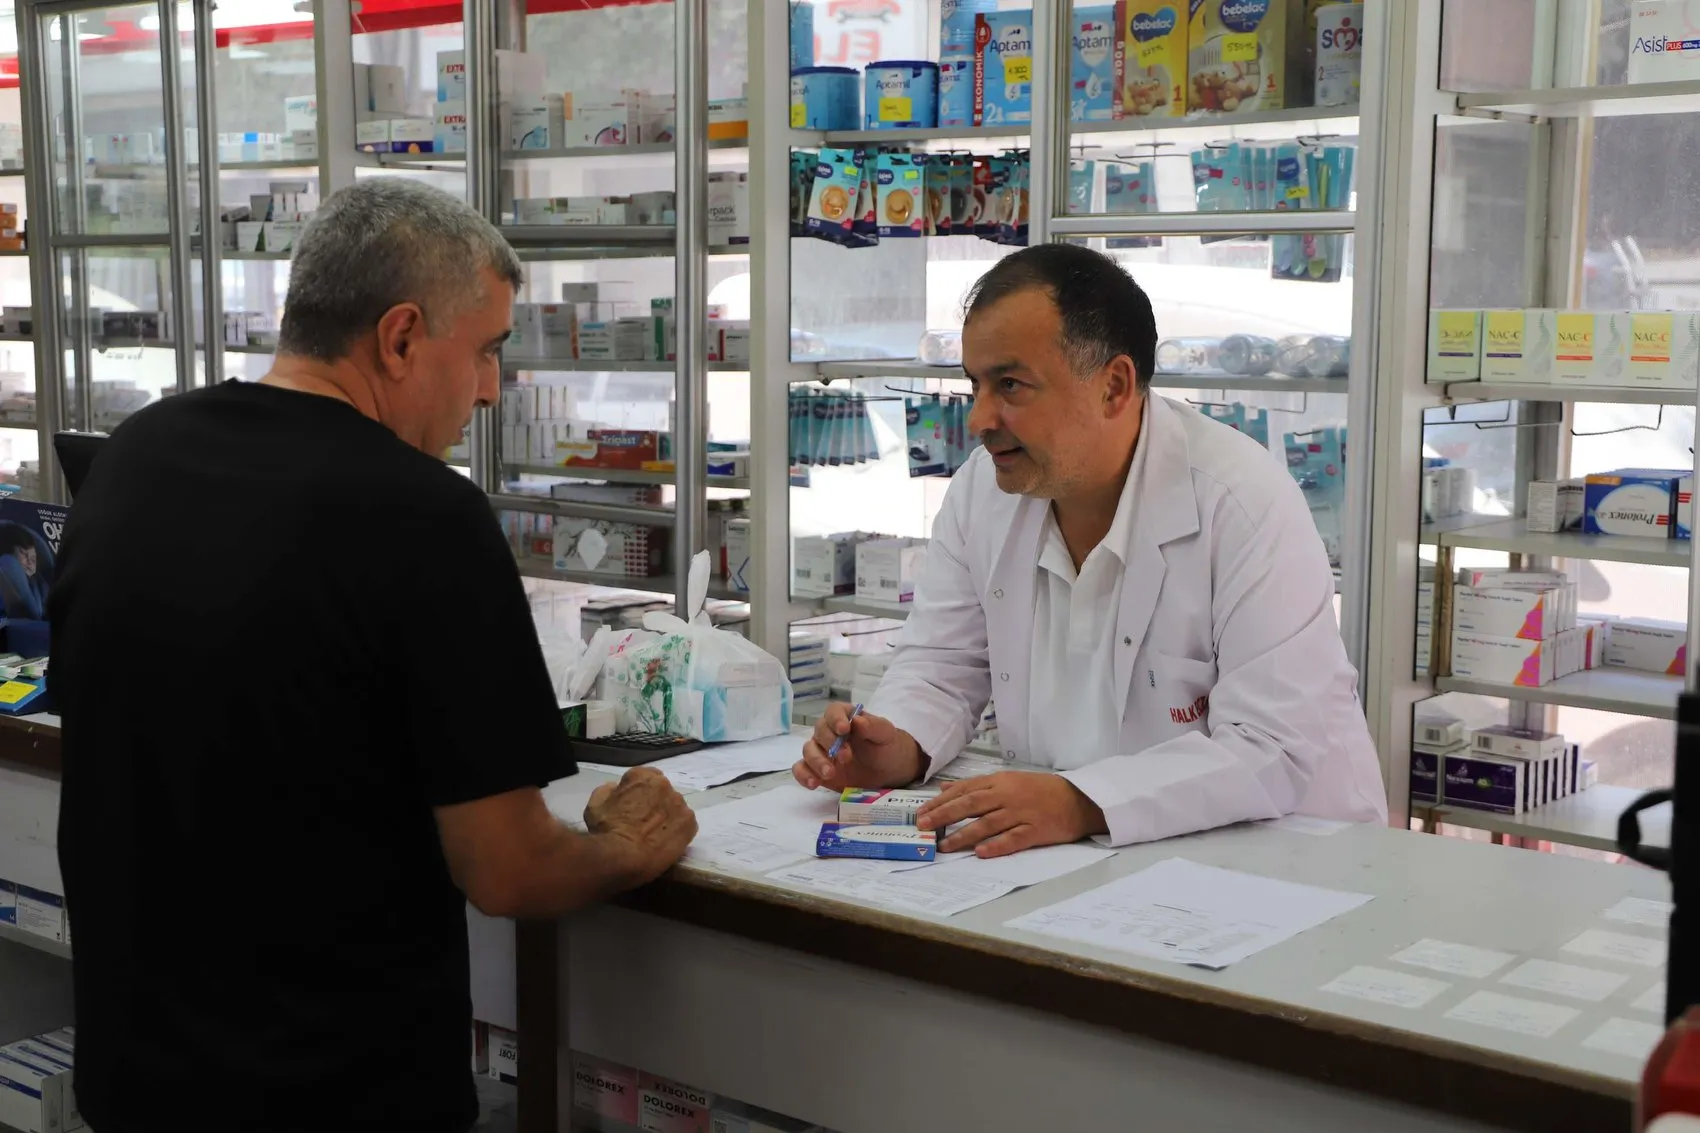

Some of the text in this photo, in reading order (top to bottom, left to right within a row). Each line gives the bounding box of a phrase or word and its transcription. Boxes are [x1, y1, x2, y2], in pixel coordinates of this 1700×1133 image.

[1222, 2, 1264, 15] bebelac
[1133, 18, 1172, 30] bebelac
[1321, 27, 1362, 51] SM
[1632, 35, 1668, 54] Asist
[1666, 42, 1682, 50] PLUS
[876, 79, 911, 90] Aptamil
[1267, 73, 1276, 88] 1
[1173, 85, 1183, 102] 1
[1488, 330, 1521, 340] NAC-C
[1558, 332, 1592, 342] NAC-C
[1634, 332, 1669, 342] NAC-C
[1608, 511, 1655, 526] Protonex
[576, 1071, 626, 1095] DOLOREX
[654, 1081, 706, 1106] DOLOREX
[643, 1094, 696, 1118] DOLOREX
